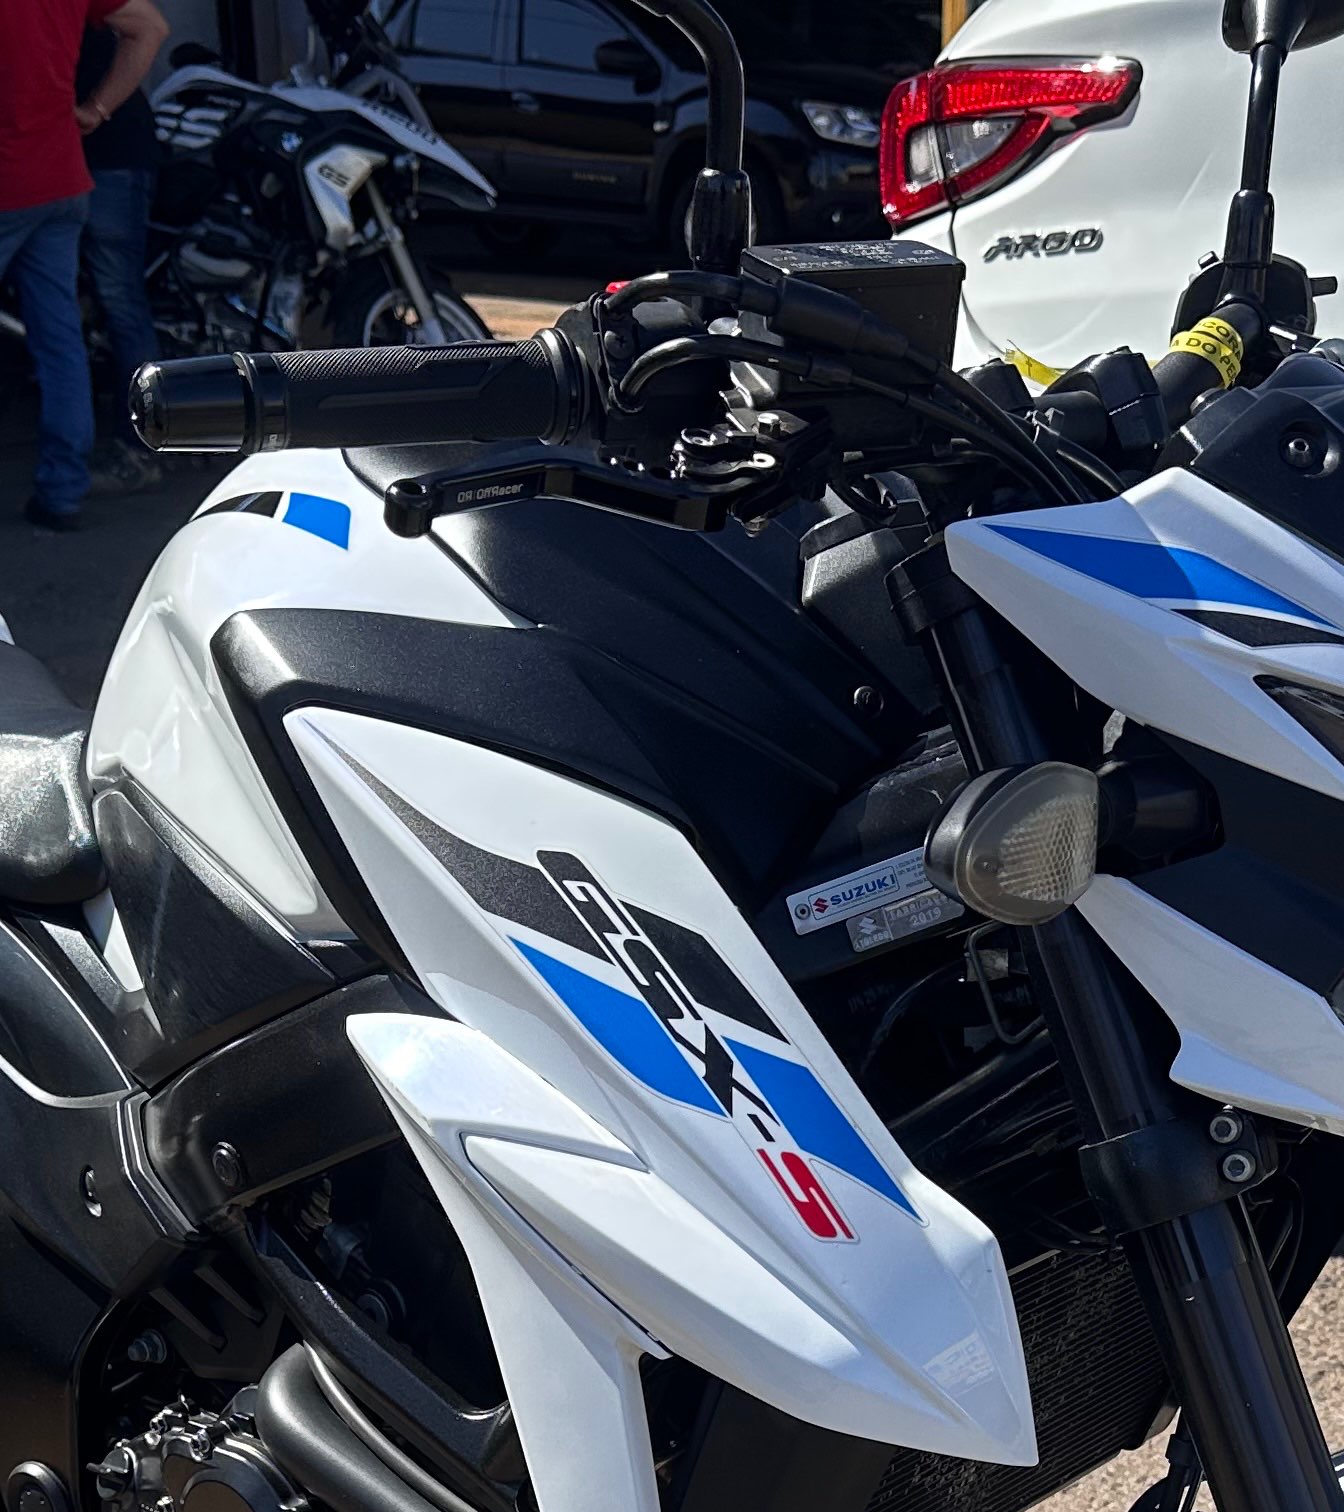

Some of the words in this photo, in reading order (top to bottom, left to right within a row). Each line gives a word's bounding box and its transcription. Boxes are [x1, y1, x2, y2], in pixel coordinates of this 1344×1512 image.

[983, 228, 1103, 262] ARGO
[1186, 338, 1217, 355] DO
[829, 873, 896, 906] SUZUKI
[909, 906, 943, 928] 2019
[536, 849, 855, 1239] GSX-S
